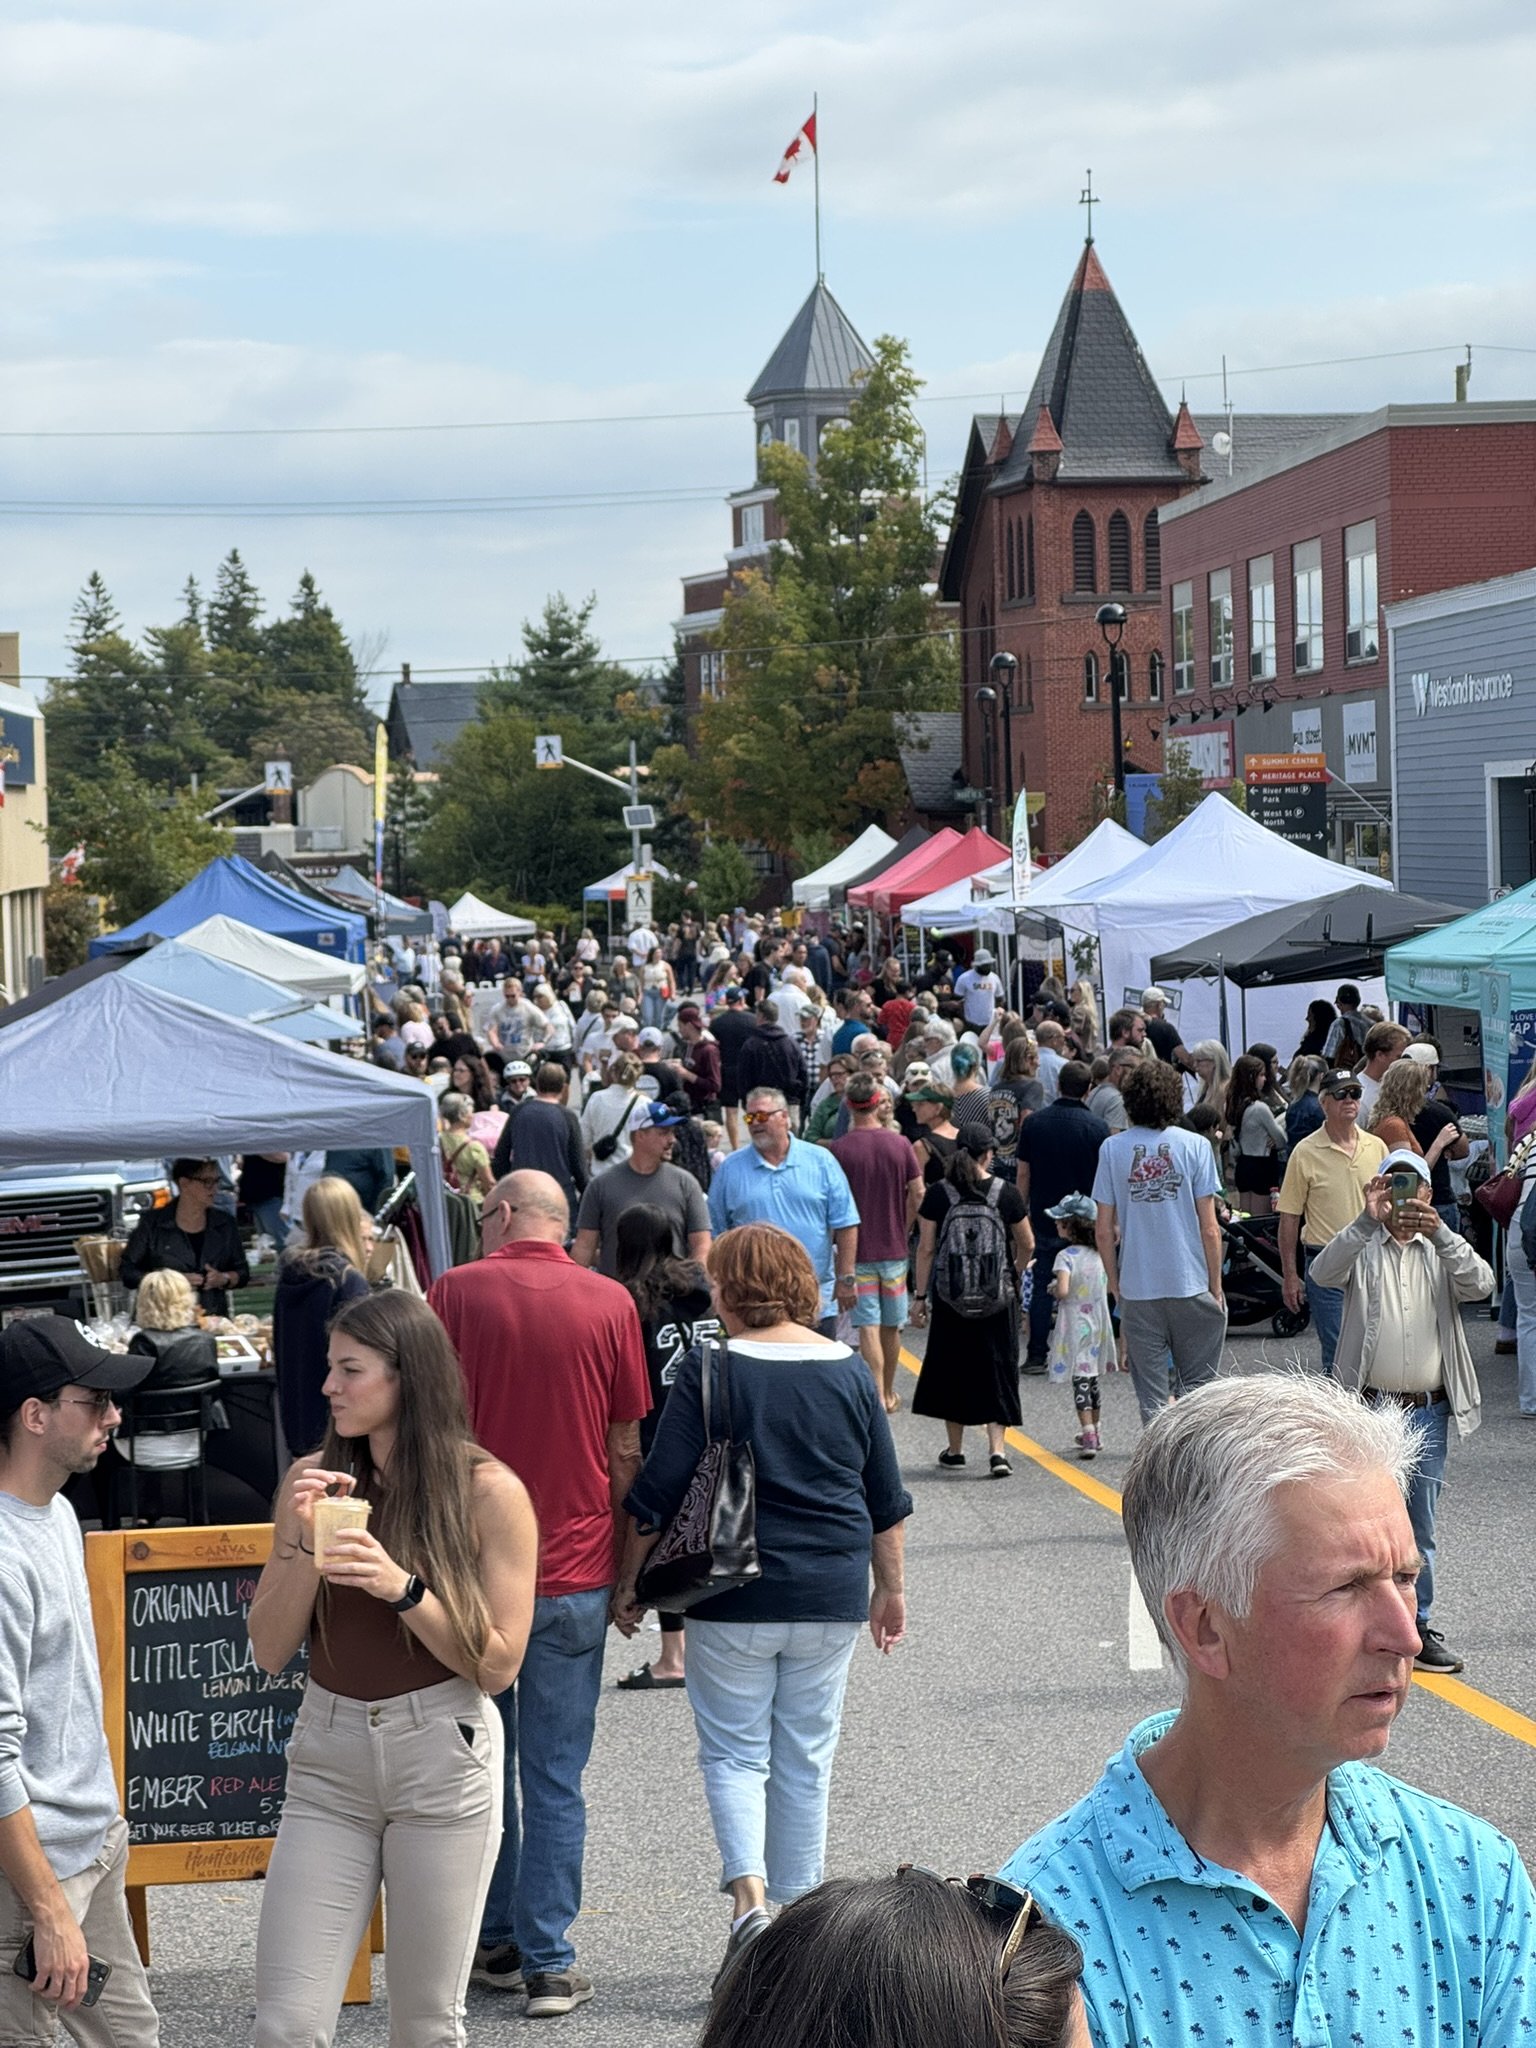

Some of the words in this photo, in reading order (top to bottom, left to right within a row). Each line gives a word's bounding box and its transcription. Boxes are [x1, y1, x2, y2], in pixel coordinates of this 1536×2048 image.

[1430, 673, 1468, 707] Westland
[1469, 673, 1513, 703] Insurance
[1262, 758, 1289, 766] SUMMIT
[1292, 757, 1319, 765] CENTRE
[1262, 772, 1296, 780] HERITAGE
[1299, 771, 1320, 779] PLACE
[1285, 786, 1299, 794] Mill
[1263, 809, 1282, 817] West
[1285, 809, 1293, 817] St
[1282, 832, 1312, 841] Parking
[193, 1543, 257, 1557] CANVAS
[132, 1580, 238, 1627] ORIGINAL
[130, 1642, 202, 1684] LITTLE
[202, 1677, 251, 1699] LEMON
[256, 1671, 305, 1693] LAGER
[128, 1709, 204, 1750] WHITE
[210, 1705, 275, 1742] BIRCH
[208, 1738, 262, 1760] BELGIAN
[128, 1774, 208, 1812] EMBER
[210, 1777, 245, 1796] RED
[248, 1775, 282, 1793] ALE
[128, 1821, 148, 1841] GET
[150, 1822, 180, 1841] YOUR
[180, 1821, 216, 1837] BEER
[219, 1820, 256, 1836] TICKET
[185, 1844, 265, 1874] Huntsville
